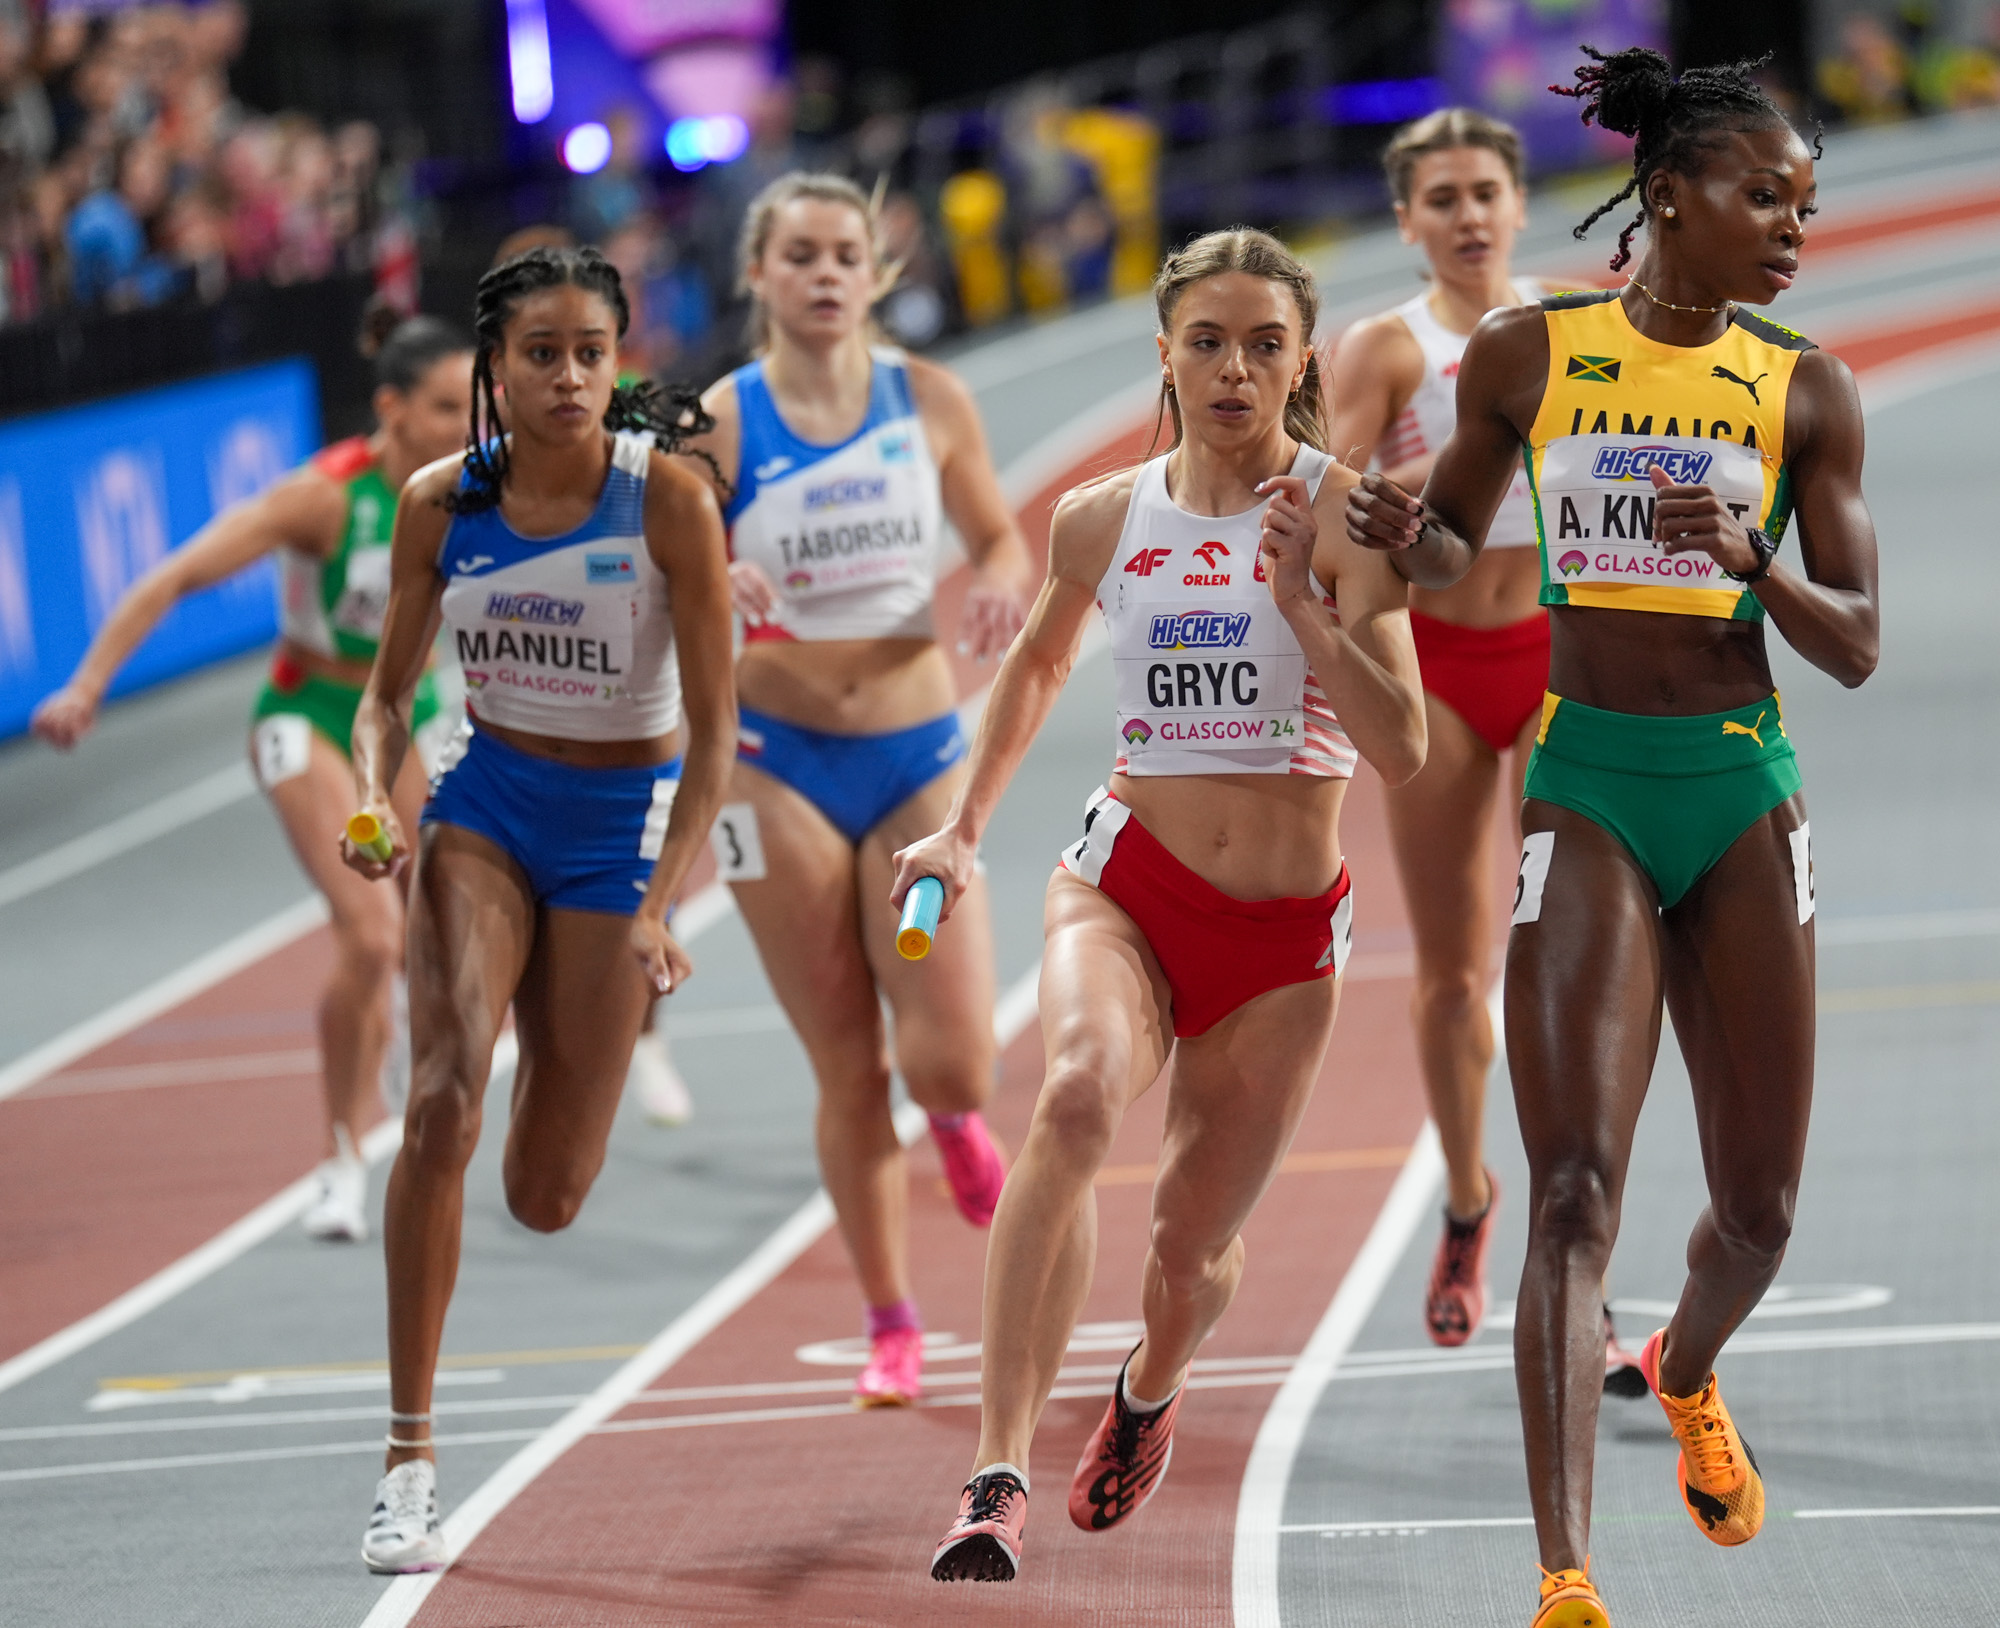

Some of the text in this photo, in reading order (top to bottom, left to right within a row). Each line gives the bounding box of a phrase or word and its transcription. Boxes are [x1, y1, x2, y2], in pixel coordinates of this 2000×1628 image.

[1558, 494, 1750, 541] A. KNT
[1124, 548, 1172, 576] 4F
[1595, 554, 1714, 578] GLASGOW
[1183, 574, 1230, 586] ORLEN
[1149, 612, 1251, 649] HI-CHEW
[456, 628, 621, 675] MANUEL
[497, 668, 597, 697] GLASGOW
[1147, 661, 1258, 707] GRYC
[1160, 719, 1295, 740] GLASGOW 24
[722, 820, 744, 869] 3
